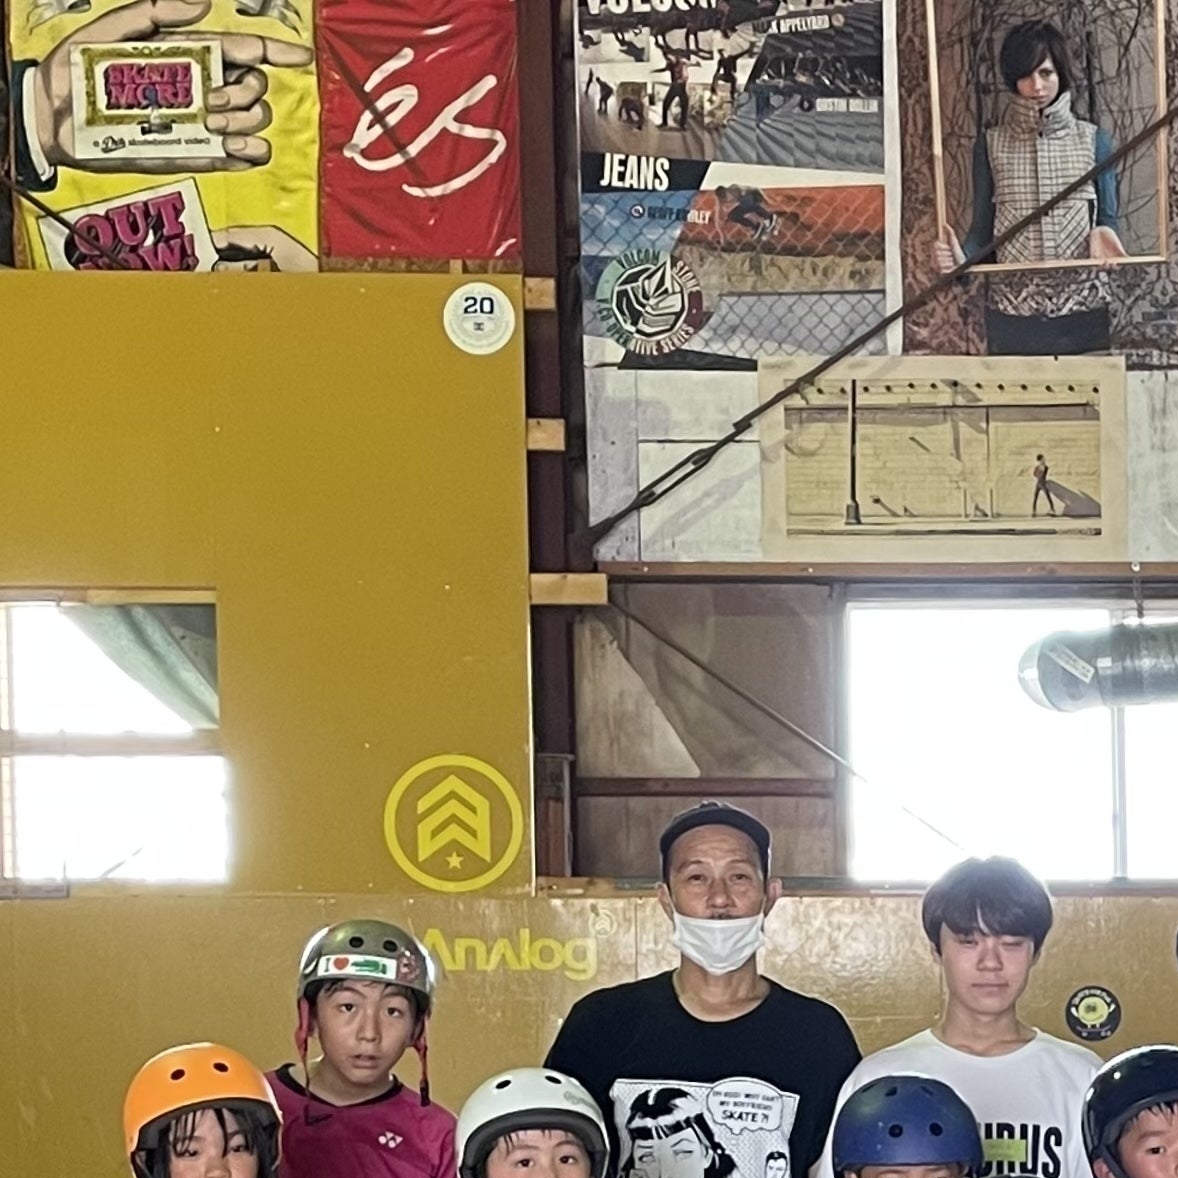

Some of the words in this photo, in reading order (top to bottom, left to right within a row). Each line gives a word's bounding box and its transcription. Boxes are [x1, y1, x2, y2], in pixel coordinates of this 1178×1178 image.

[105, 62, 192, 84] SKATE
[600, 153, 670, 191] JEANS
[73, 190, 186, 256] OUT
[463, 295, 495, 315] 20
[721, 1109, 759, 1123] SKATE
